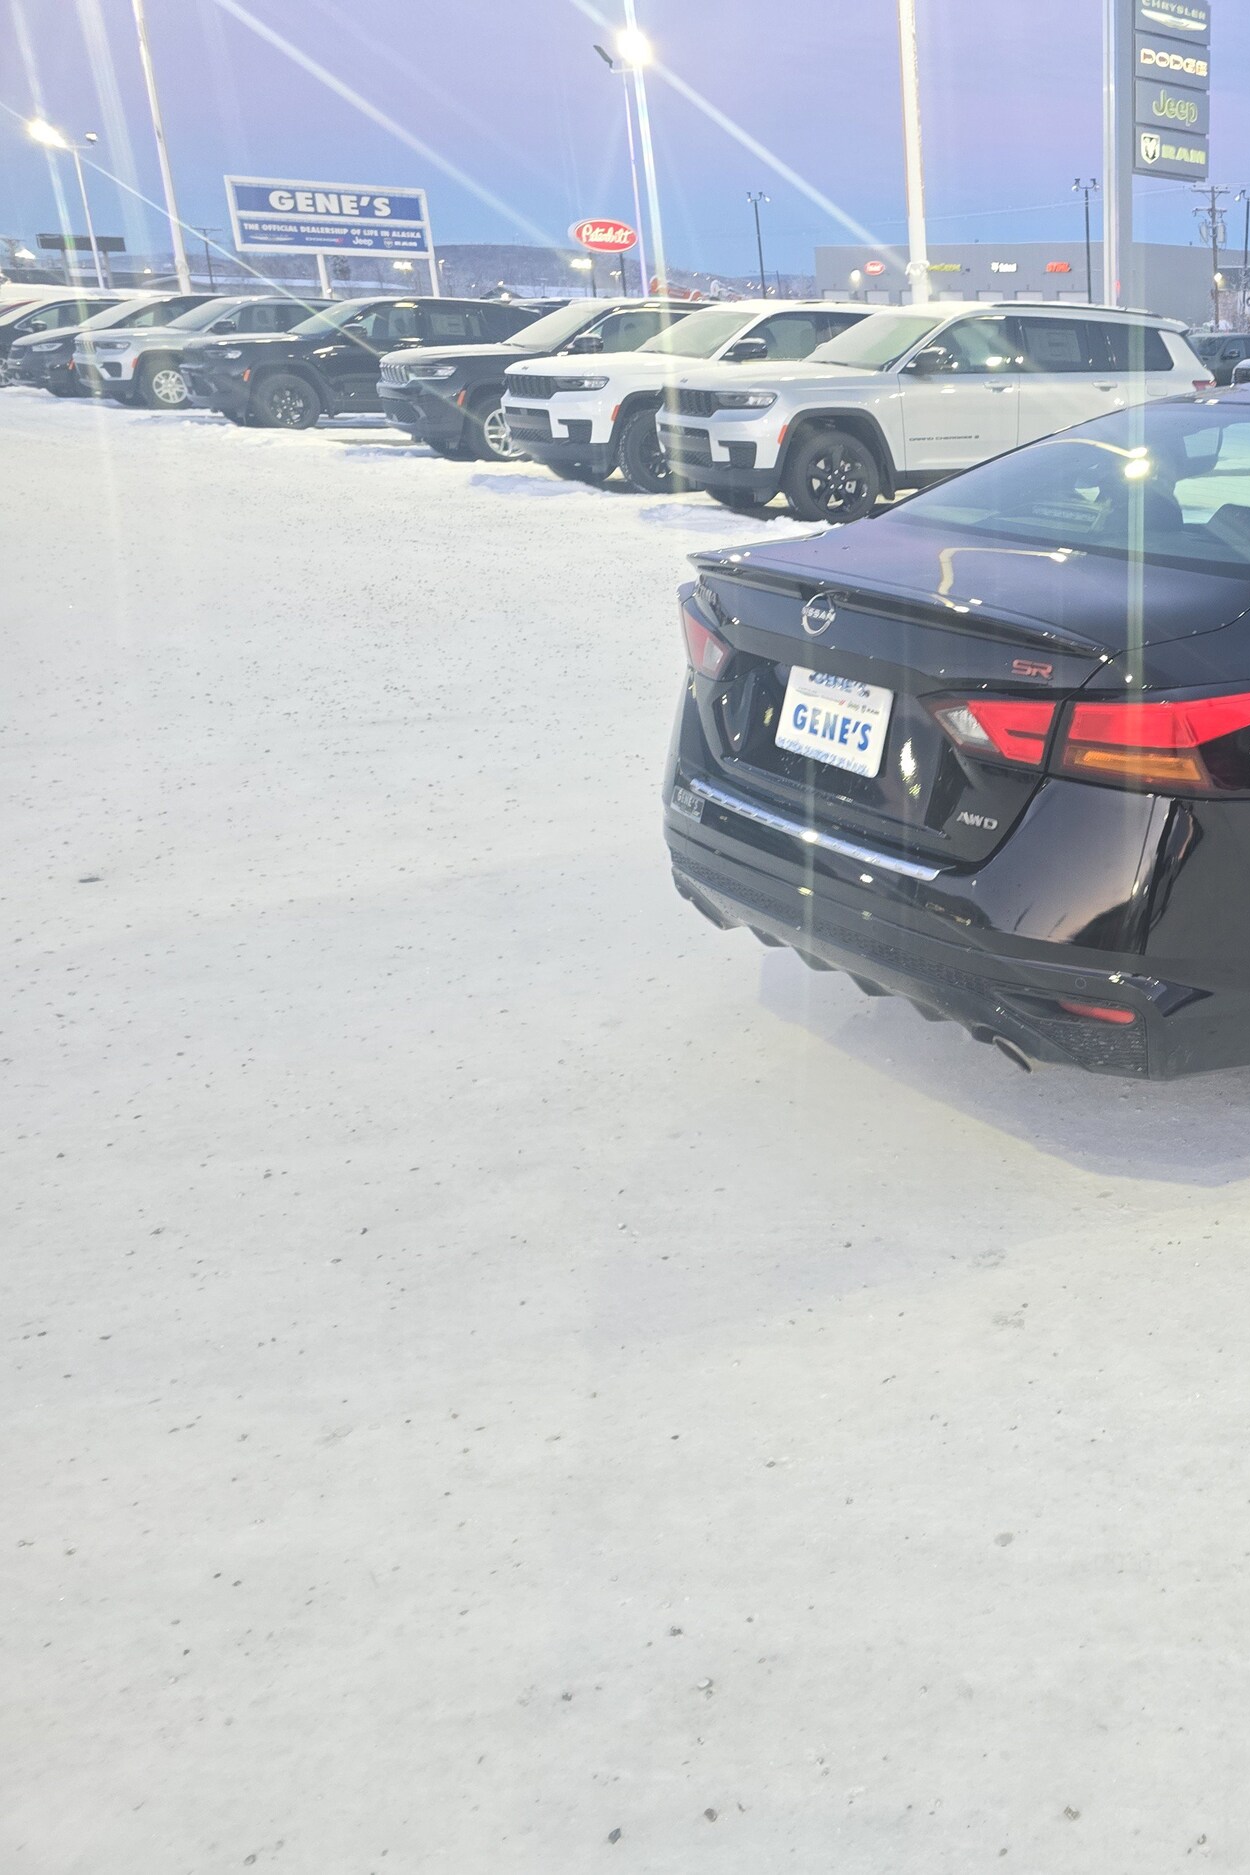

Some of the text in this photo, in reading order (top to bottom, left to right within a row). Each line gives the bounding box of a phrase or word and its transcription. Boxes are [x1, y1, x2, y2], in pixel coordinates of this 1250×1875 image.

[1142, 0, 1206, 20] CHRYSLER
[1140, 47, 1208, 77] DODGE
[1152, 89, 1198, 127] Jeep
[1161, 144, 1206, 165] RAM
[268, 190, 392, 217] GENE'S
[243, 223, 260, 231] THE
[261, 224, 298, 233] OFFICIAL
[300, 226, 349, 236] DEALERSHIP
[351, 228, 362, 236] OF
[363, 229, 379, 237] LIFE
[391, 230, 422, 239] ALASKA
[581, 223, 634, 244] Peterbilt
[352, 236, 374, 247] Jeep
[801, 606, 837, 621] NISSAN
[1011, 659, 1053, 679] SR
[792, 703, 872, 752] GENE'S
[957, 811, 998, 830] AWD
